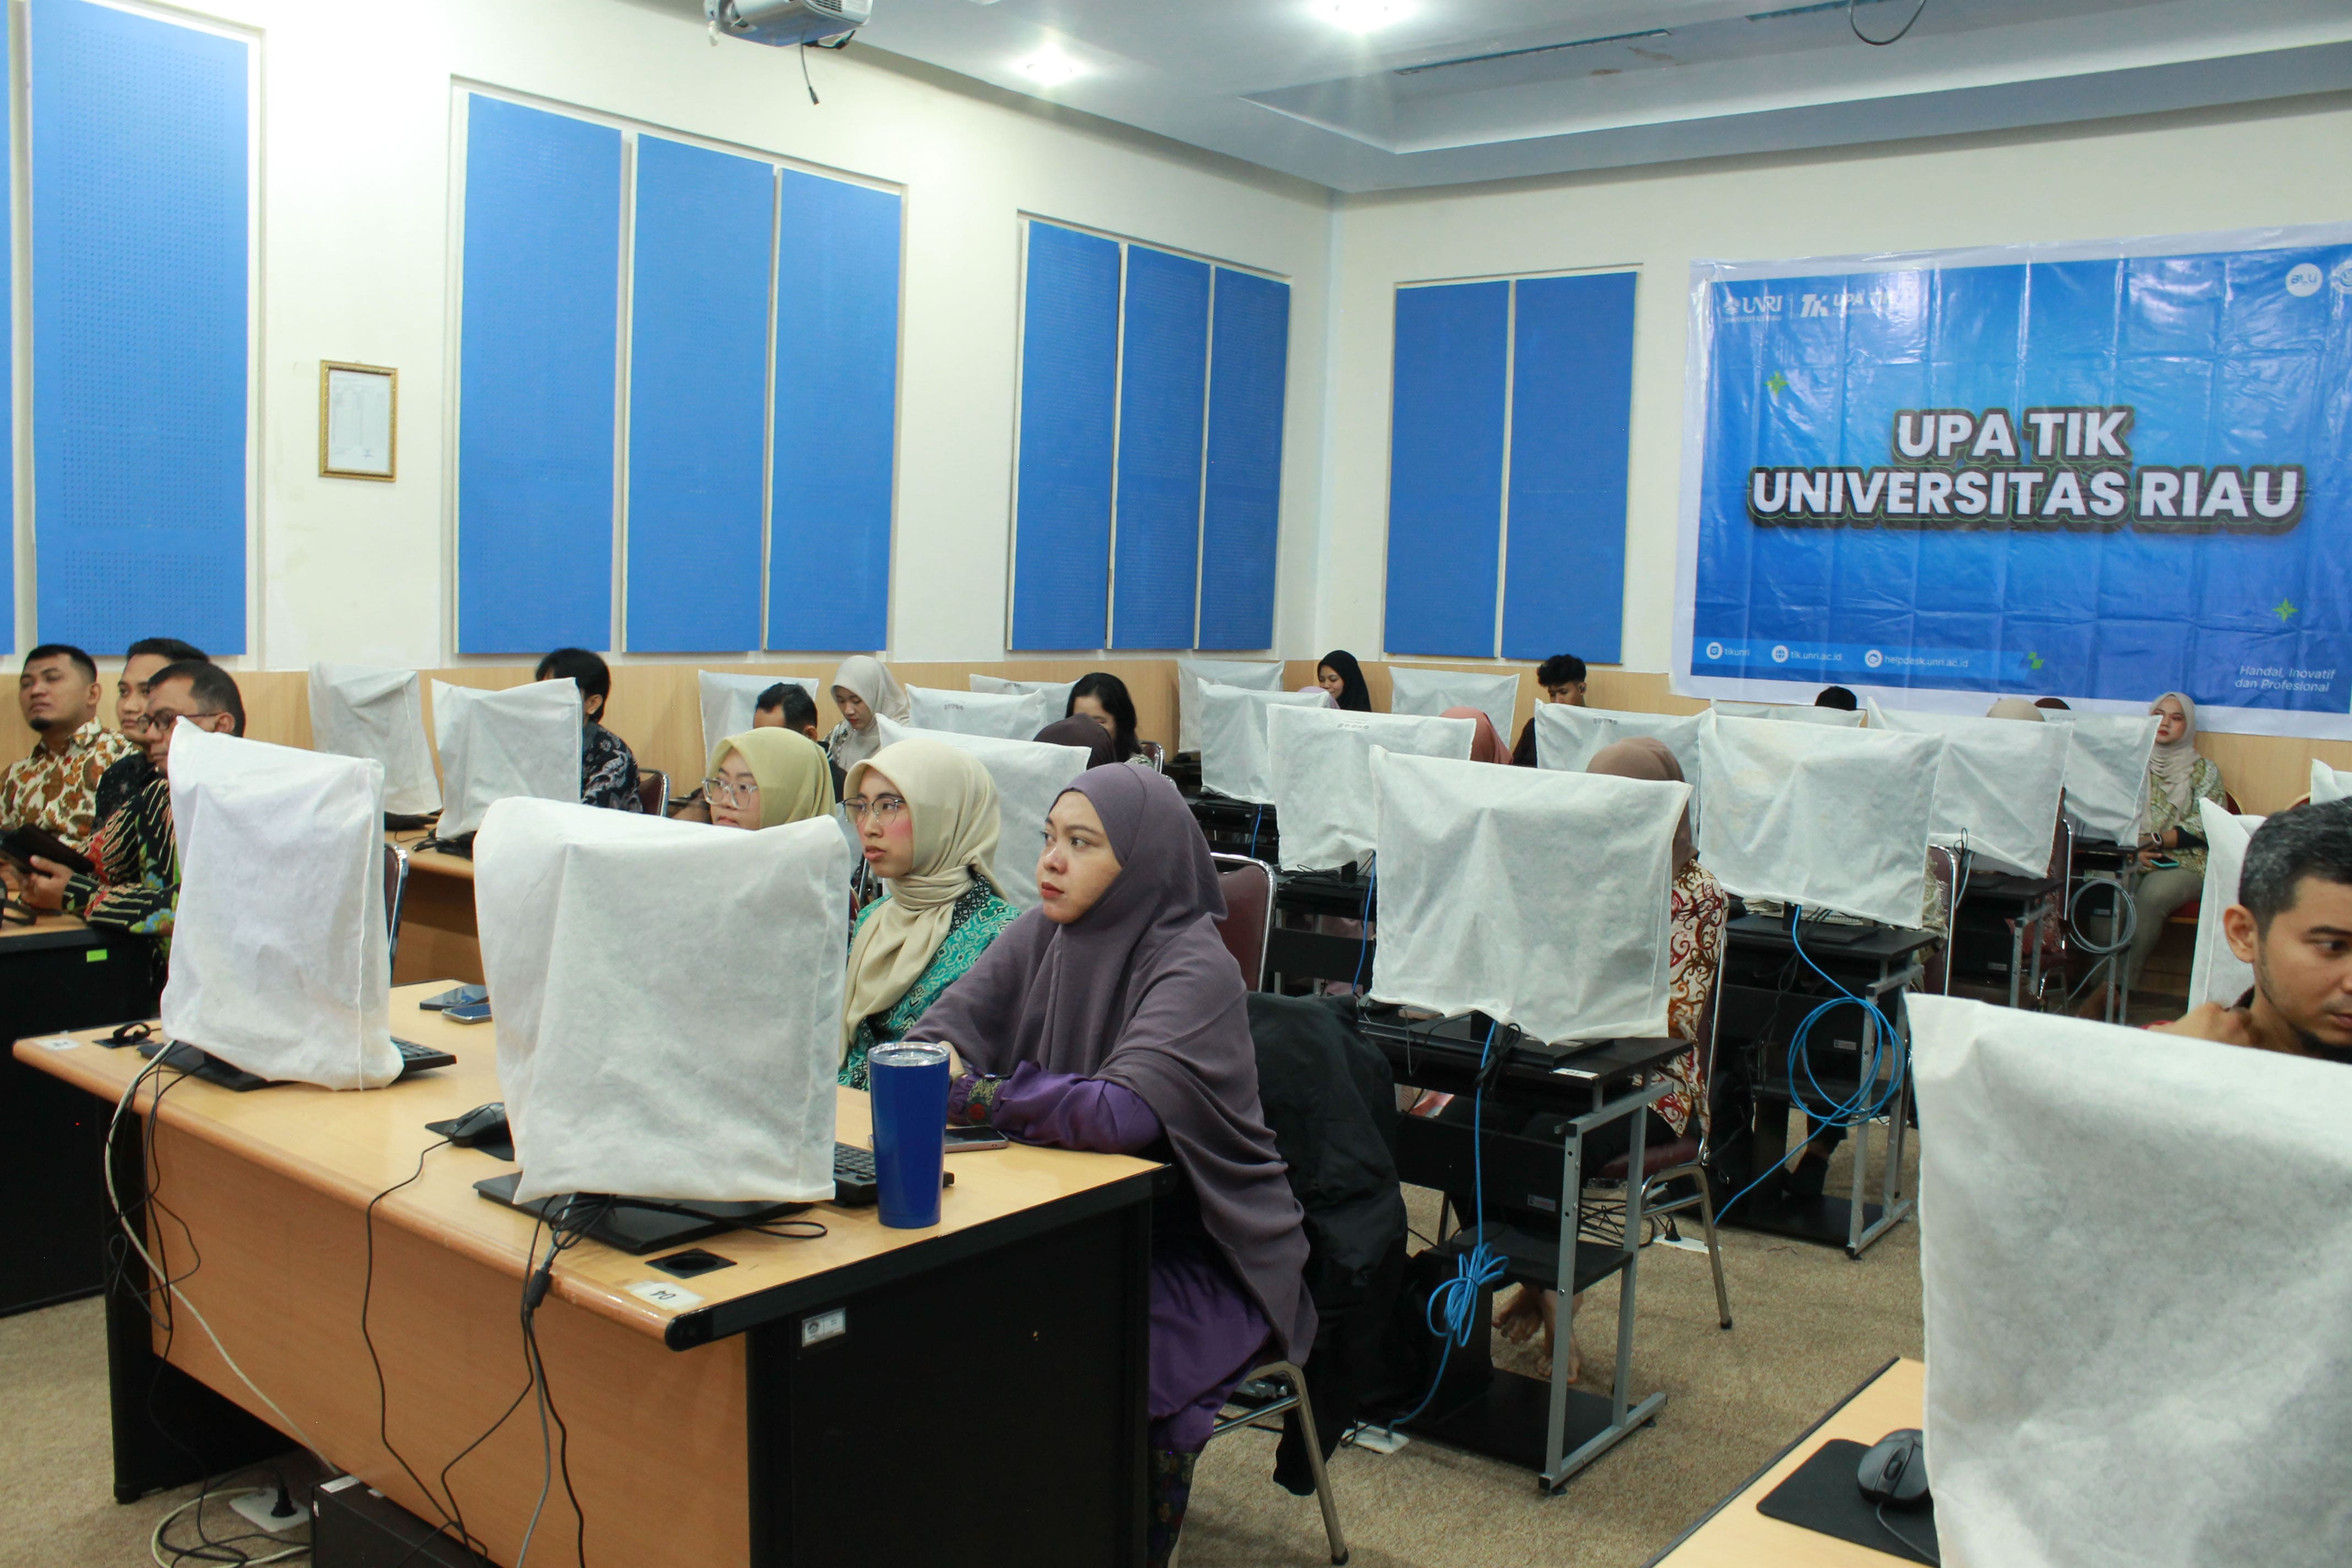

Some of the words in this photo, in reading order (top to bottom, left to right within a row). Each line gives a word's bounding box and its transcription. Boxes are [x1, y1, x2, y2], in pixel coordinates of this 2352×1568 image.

[1743, 296, 1783, 313] UNRI
[1899, 414, 2016, 457] UPA
[2029, 412, 2127, 456] TIK
[1754, 471, 2124, 516] UNIVERSITAS
[2140, 472, 2297, 518] RIAU
[1790, 651, 1842, 661] tik.unri.ac.id
[2240, 666, 2284, 678] Handal,
[2289, 668, 2337, 679] Inovatif
[2235, 678, 2257, 688] dan
[2261, 679, 2331, 692] Profesional
